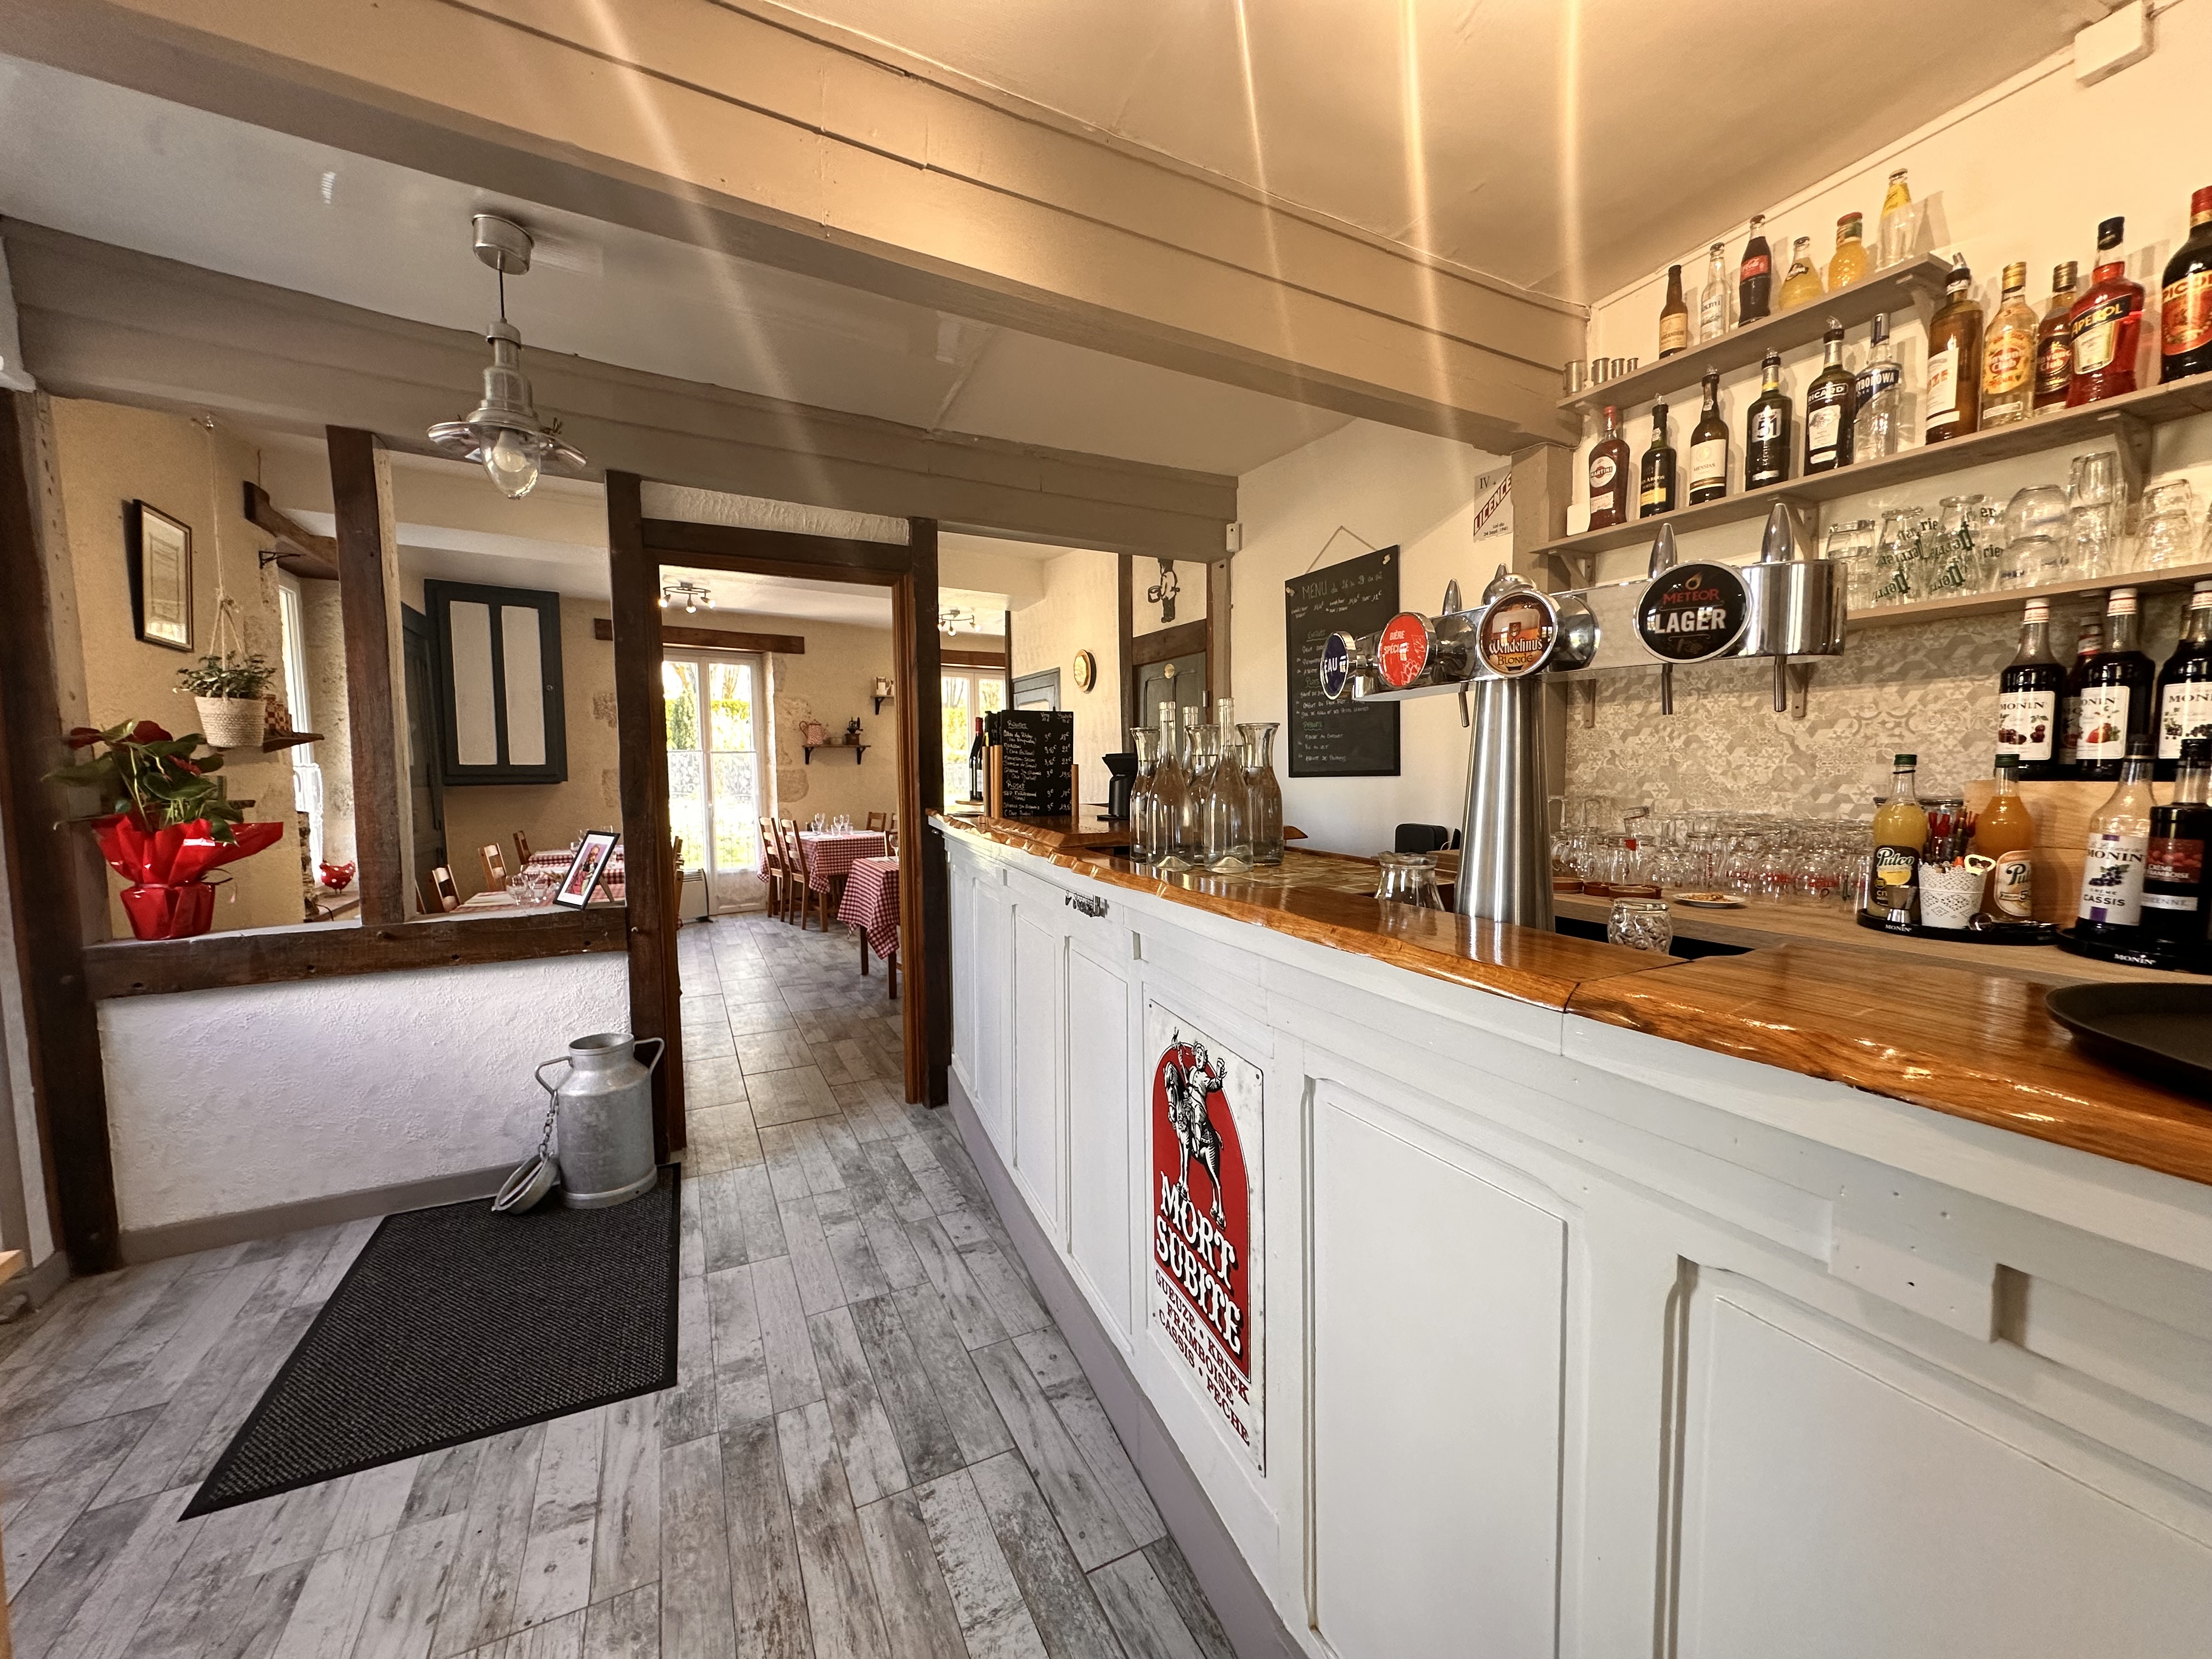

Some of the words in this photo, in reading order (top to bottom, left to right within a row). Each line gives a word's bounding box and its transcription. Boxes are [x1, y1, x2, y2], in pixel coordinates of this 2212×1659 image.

[2072, 303, 2123, 336] APEROL
[1991, 359, 2017, 373] Club
[1808, 385, 1845, 403] RICARD
[1757, 417, 1777, 438] 51
[1591, 466, 1612, 477] MARTINI
[1302, 580, 1328, 600] MENU
[1662, 588, 1720, 605] METEOR
[1654, 608, 1726, 634] LAGER
[1389, 629, 1405, 641] BIÈRE
[1324, 656, 1338, 673] EAU
[1876, 847, 1915, 867] Pulco
[2084, 894, 2126, 906] CASSIS
[1885, 924, 1912, 932] MONIN
[2113, 953, 2155, 965] MONIN
[1160, 1170, 1235, 1290] MORT
[1156, 1215, 1241, 1355] SUBITE
[1155, 1269, 1196, 1332] GUEUZE
[1207, 1335, 1250, 1406] KRIEK
[1167, 1300, 1234, 1406] FRAMBOISE
[1159, 1309, 1195, 1368] CASSIS
[1206, 1373, 1250, 1447] PECHE
